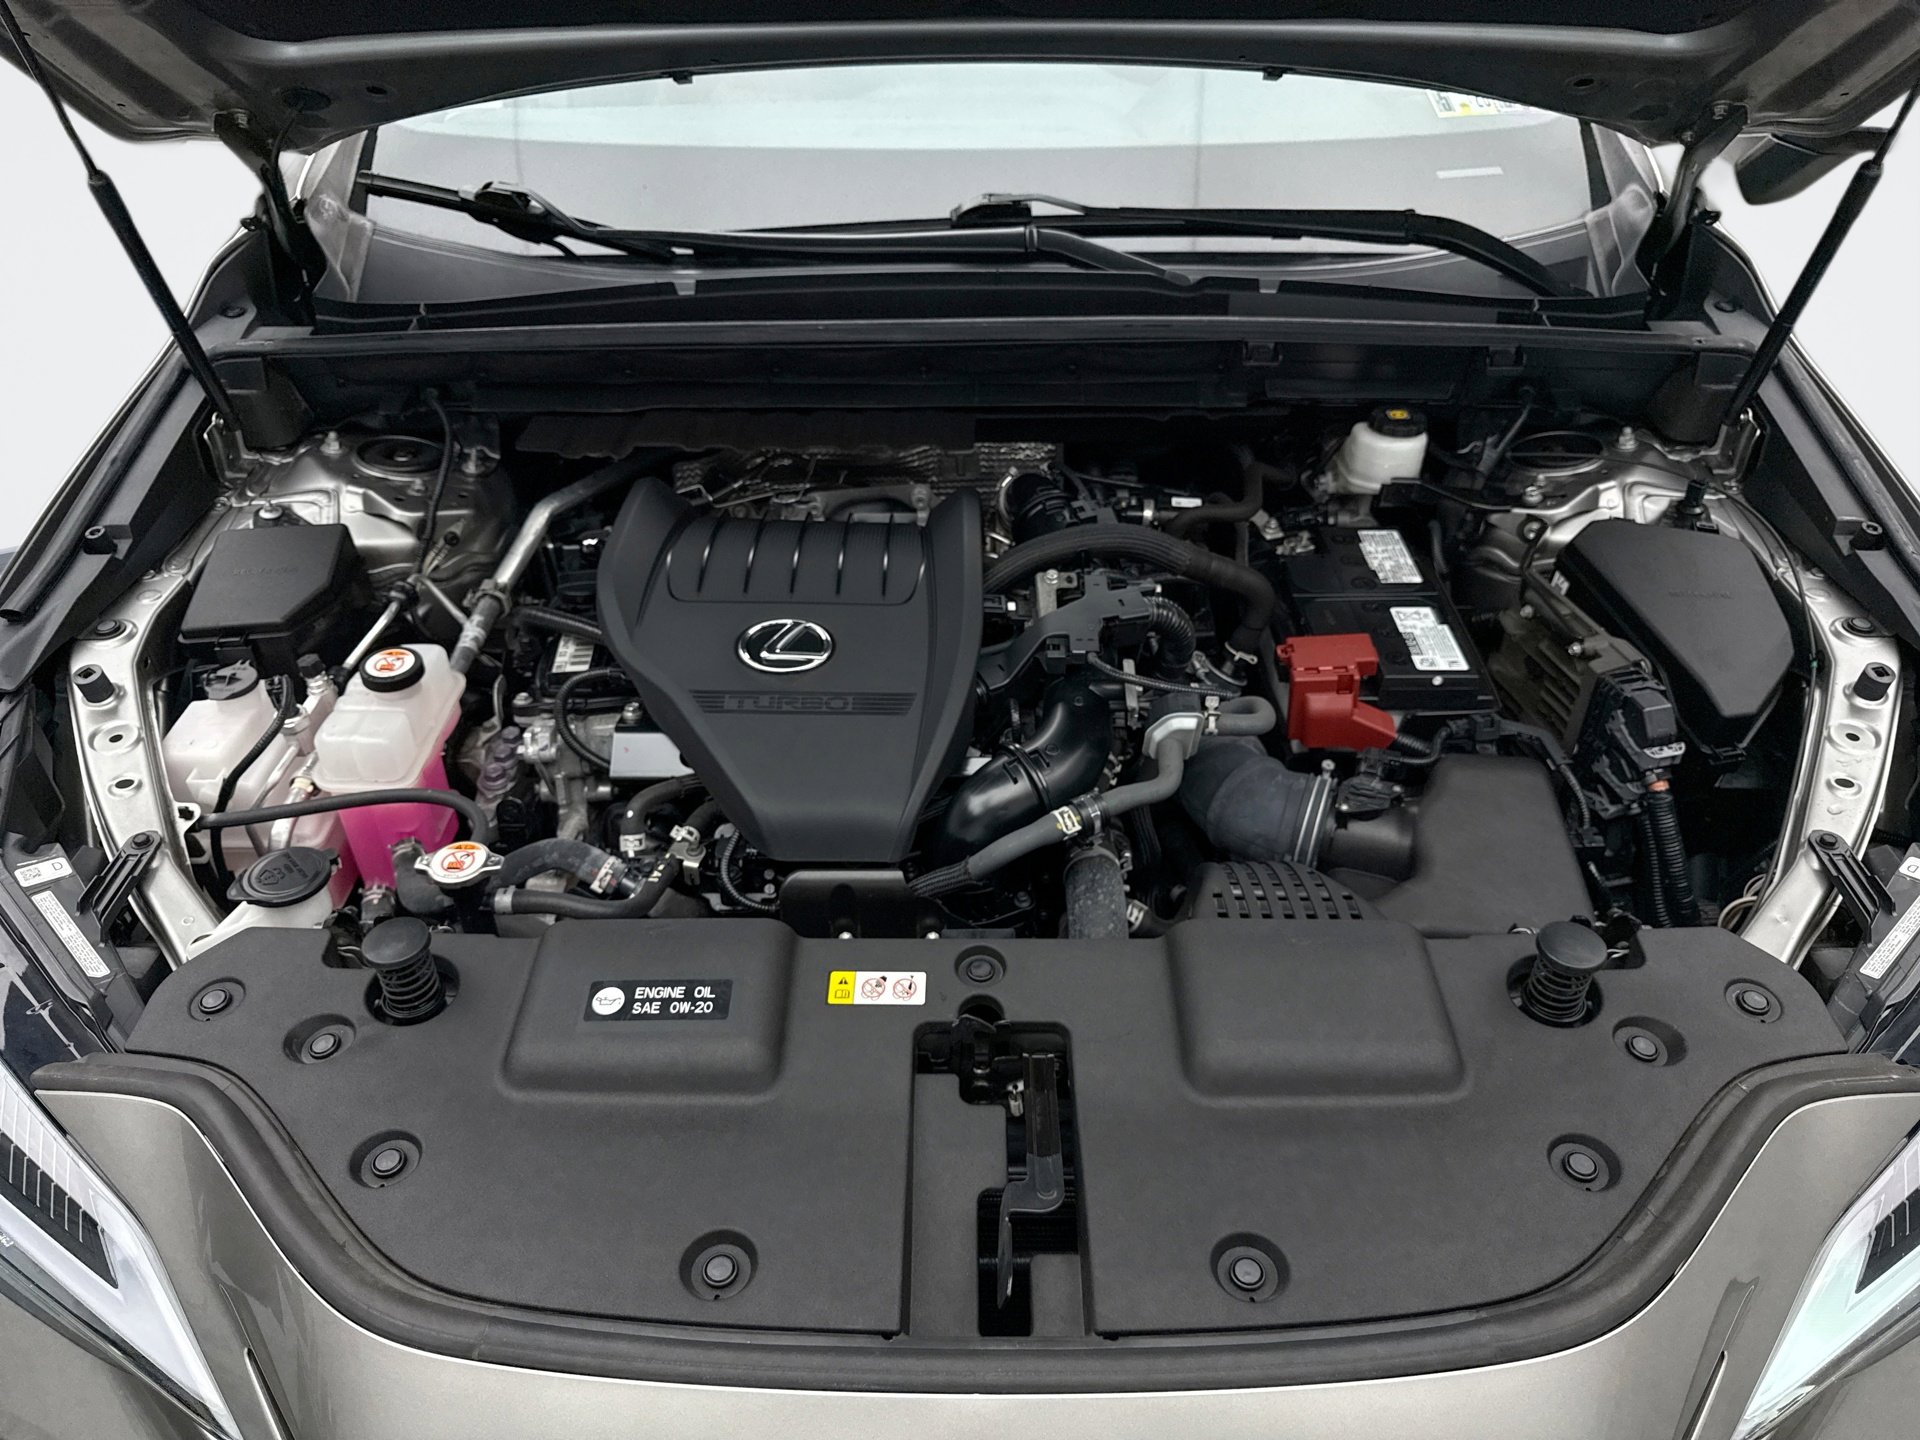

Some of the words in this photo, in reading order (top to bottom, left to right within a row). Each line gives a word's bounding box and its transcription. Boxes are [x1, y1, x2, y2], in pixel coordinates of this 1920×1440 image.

[728, 695, 850, 711] TURBO
[634, 986, 686, 999] ENGINE
[693, 986, 716, 999] OIL
[631, 1001, 662, 1014] SAE
